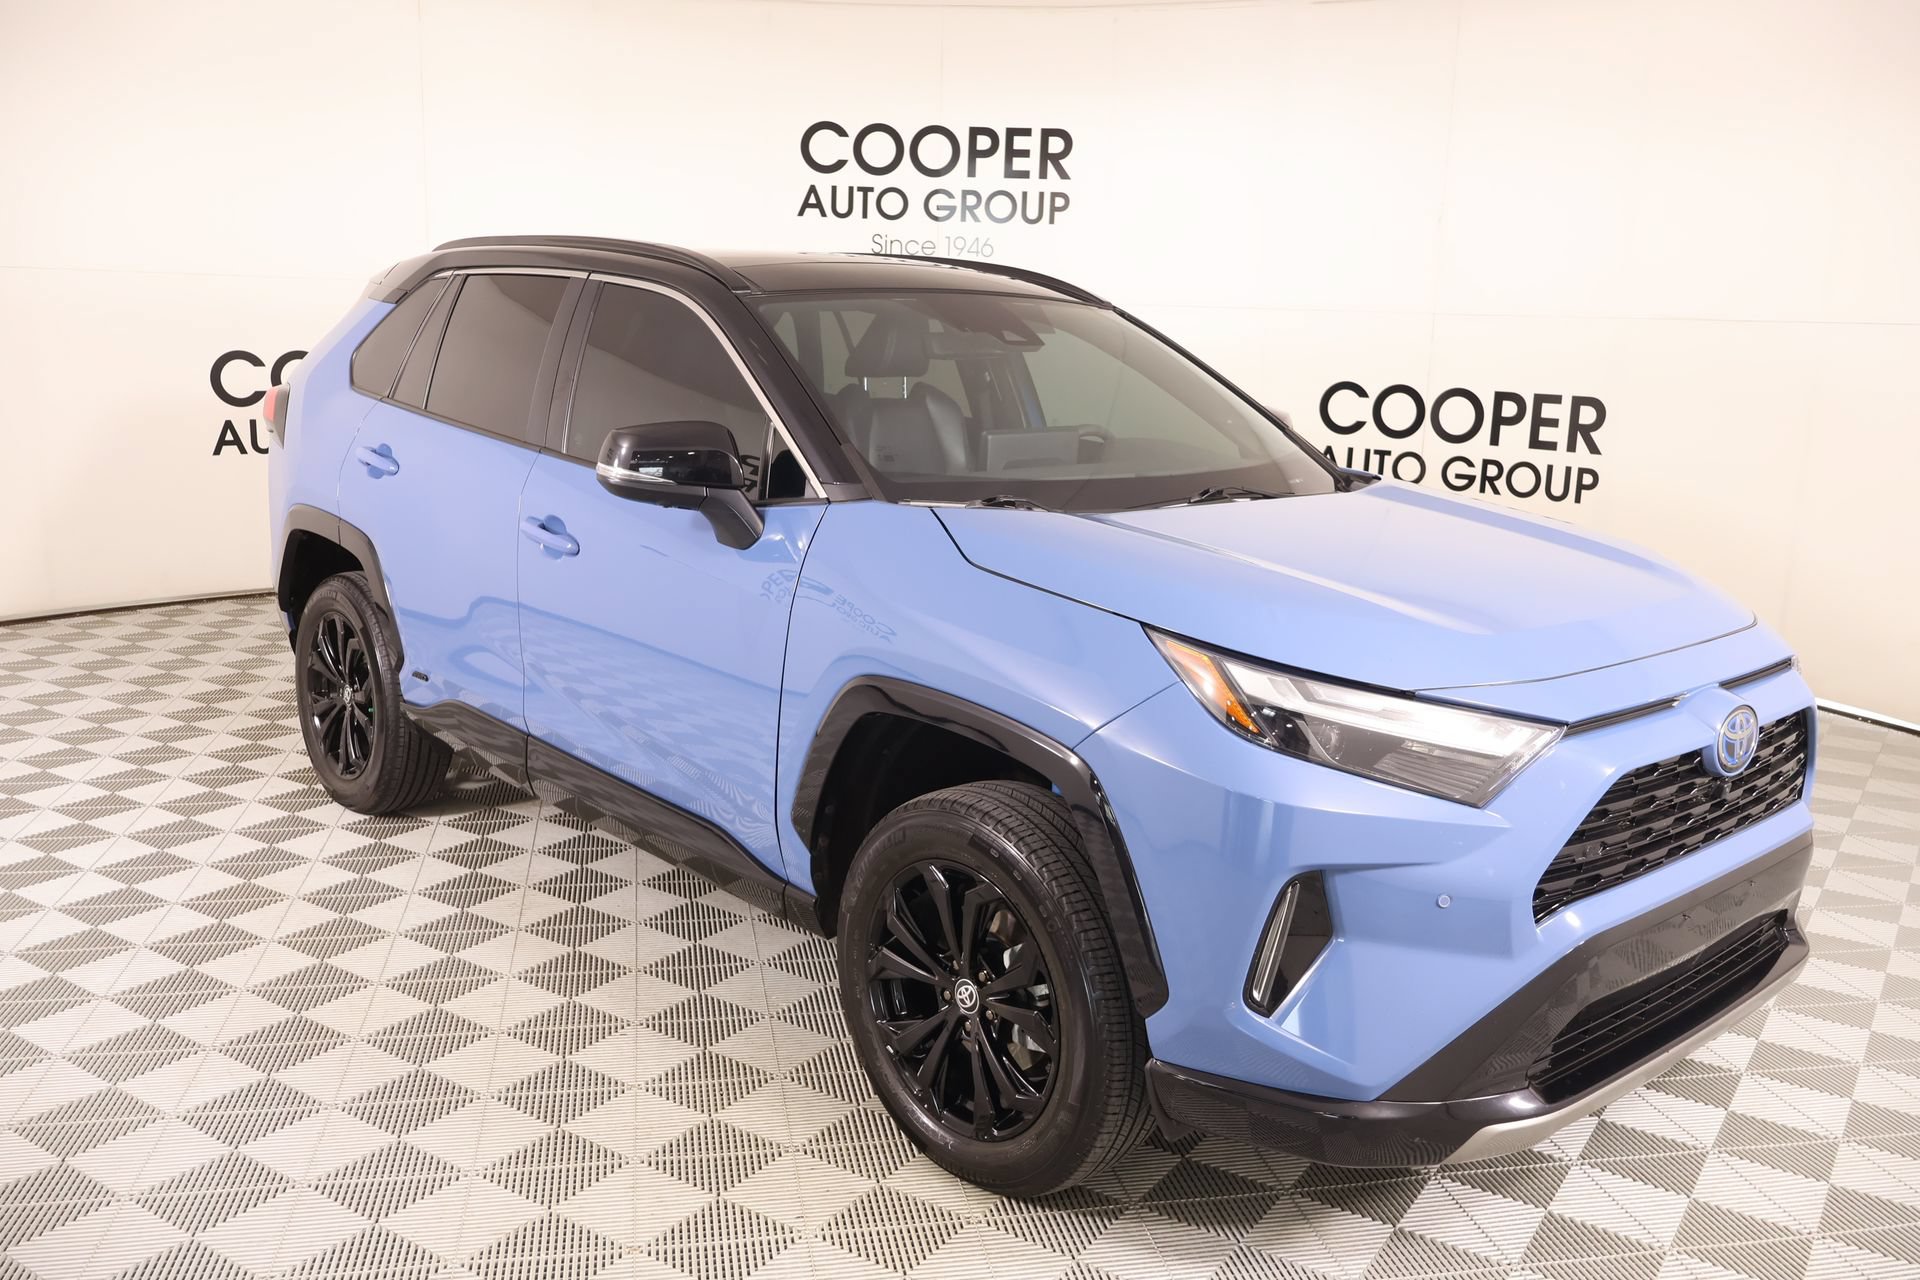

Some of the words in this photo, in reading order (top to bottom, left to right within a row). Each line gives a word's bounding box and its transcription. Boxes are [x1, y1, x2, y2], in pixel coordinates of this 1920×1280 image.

[800, 121, 1073, 180] COOPER
[797, 185, 909, 220] AUTO
[924, 188, 1070, 225] GROUP
[871, 233, 937, 255] Since
[945, 236, 995, 258] 1946
[1319, 381, 1607, 456] COOPER
[1441, 455, 1600, 504] GROUP
